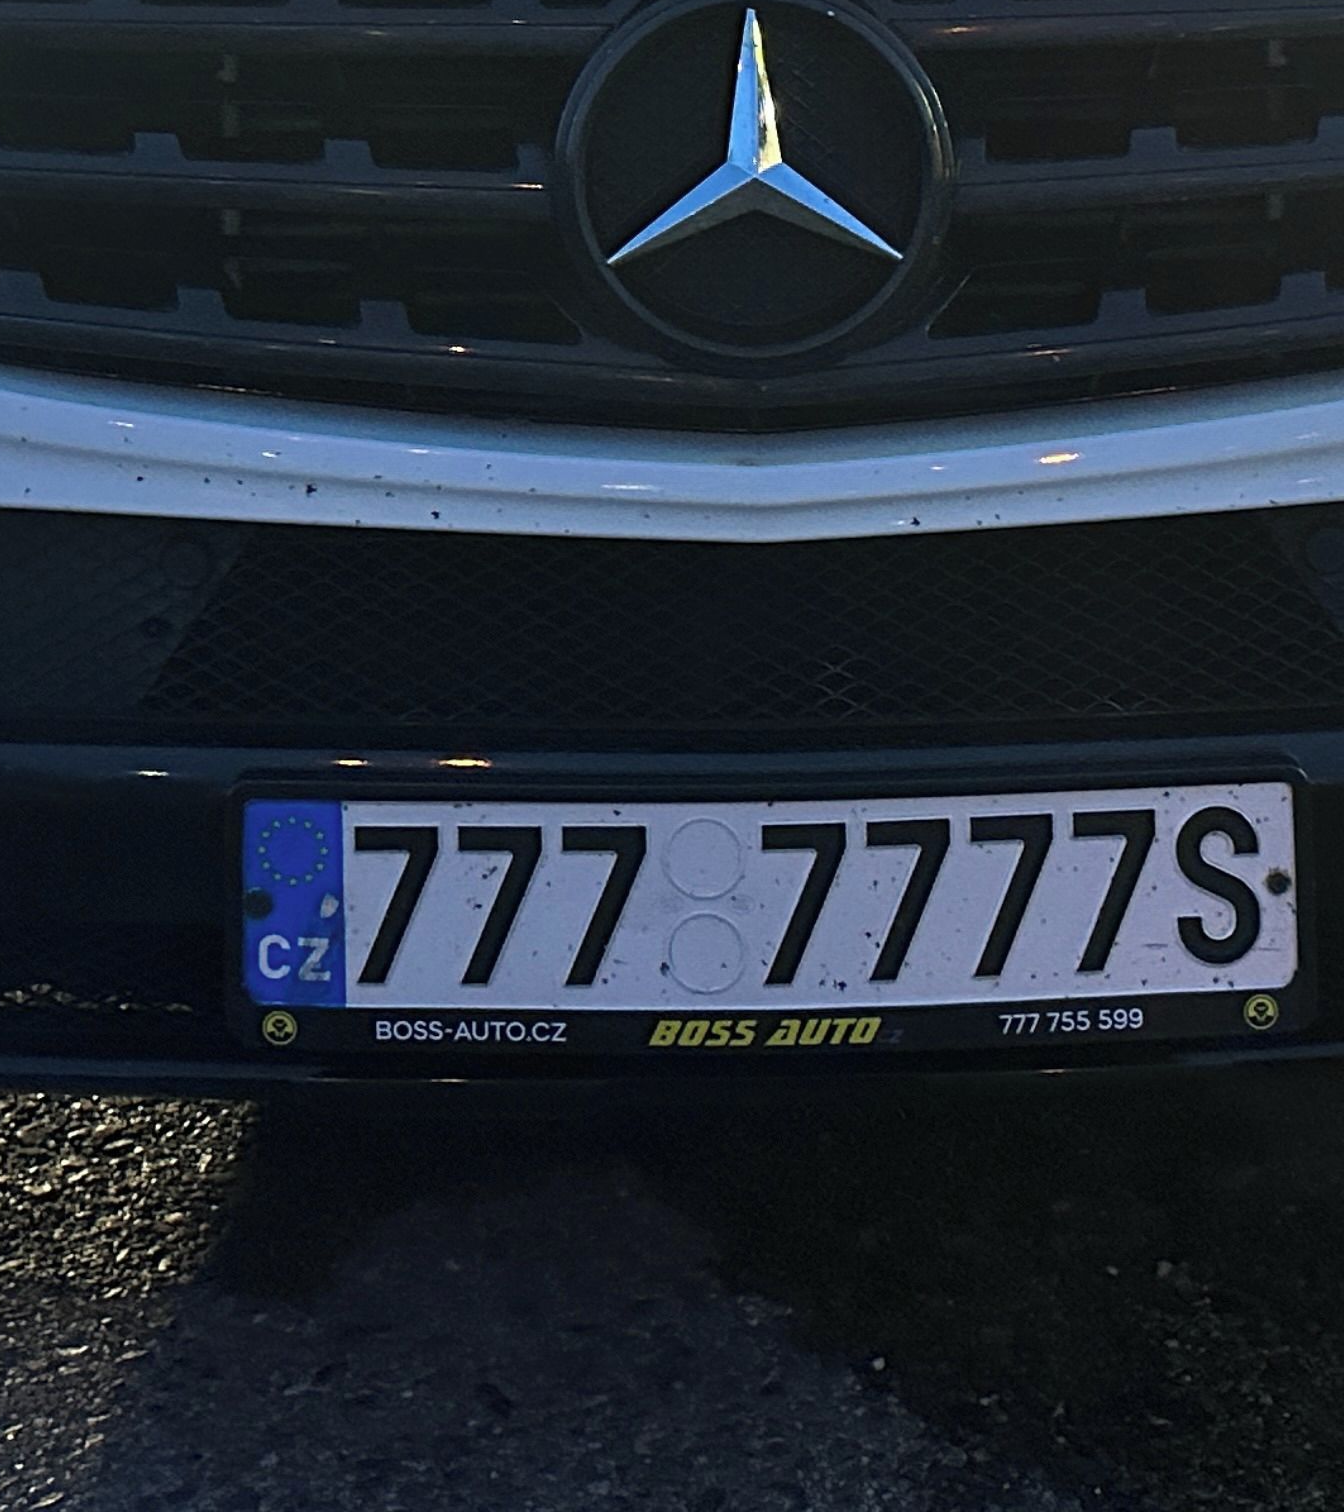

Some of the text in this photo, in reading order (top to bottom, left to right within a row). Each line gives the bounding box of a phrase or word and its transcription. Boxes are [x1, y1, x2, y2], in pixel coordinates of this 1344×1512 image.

[353, 805, 1260, 987] 777 7777S
[257, 934, 333, 982] CZ
[375, 1020, 567, 1042] BOSS-AUTO.CZ
[649, 1019, 756, 1046] BOSS
[763, 1016, 883, 1046] AUTO
[999, 1008, 1144, 1034] 777 755 599
